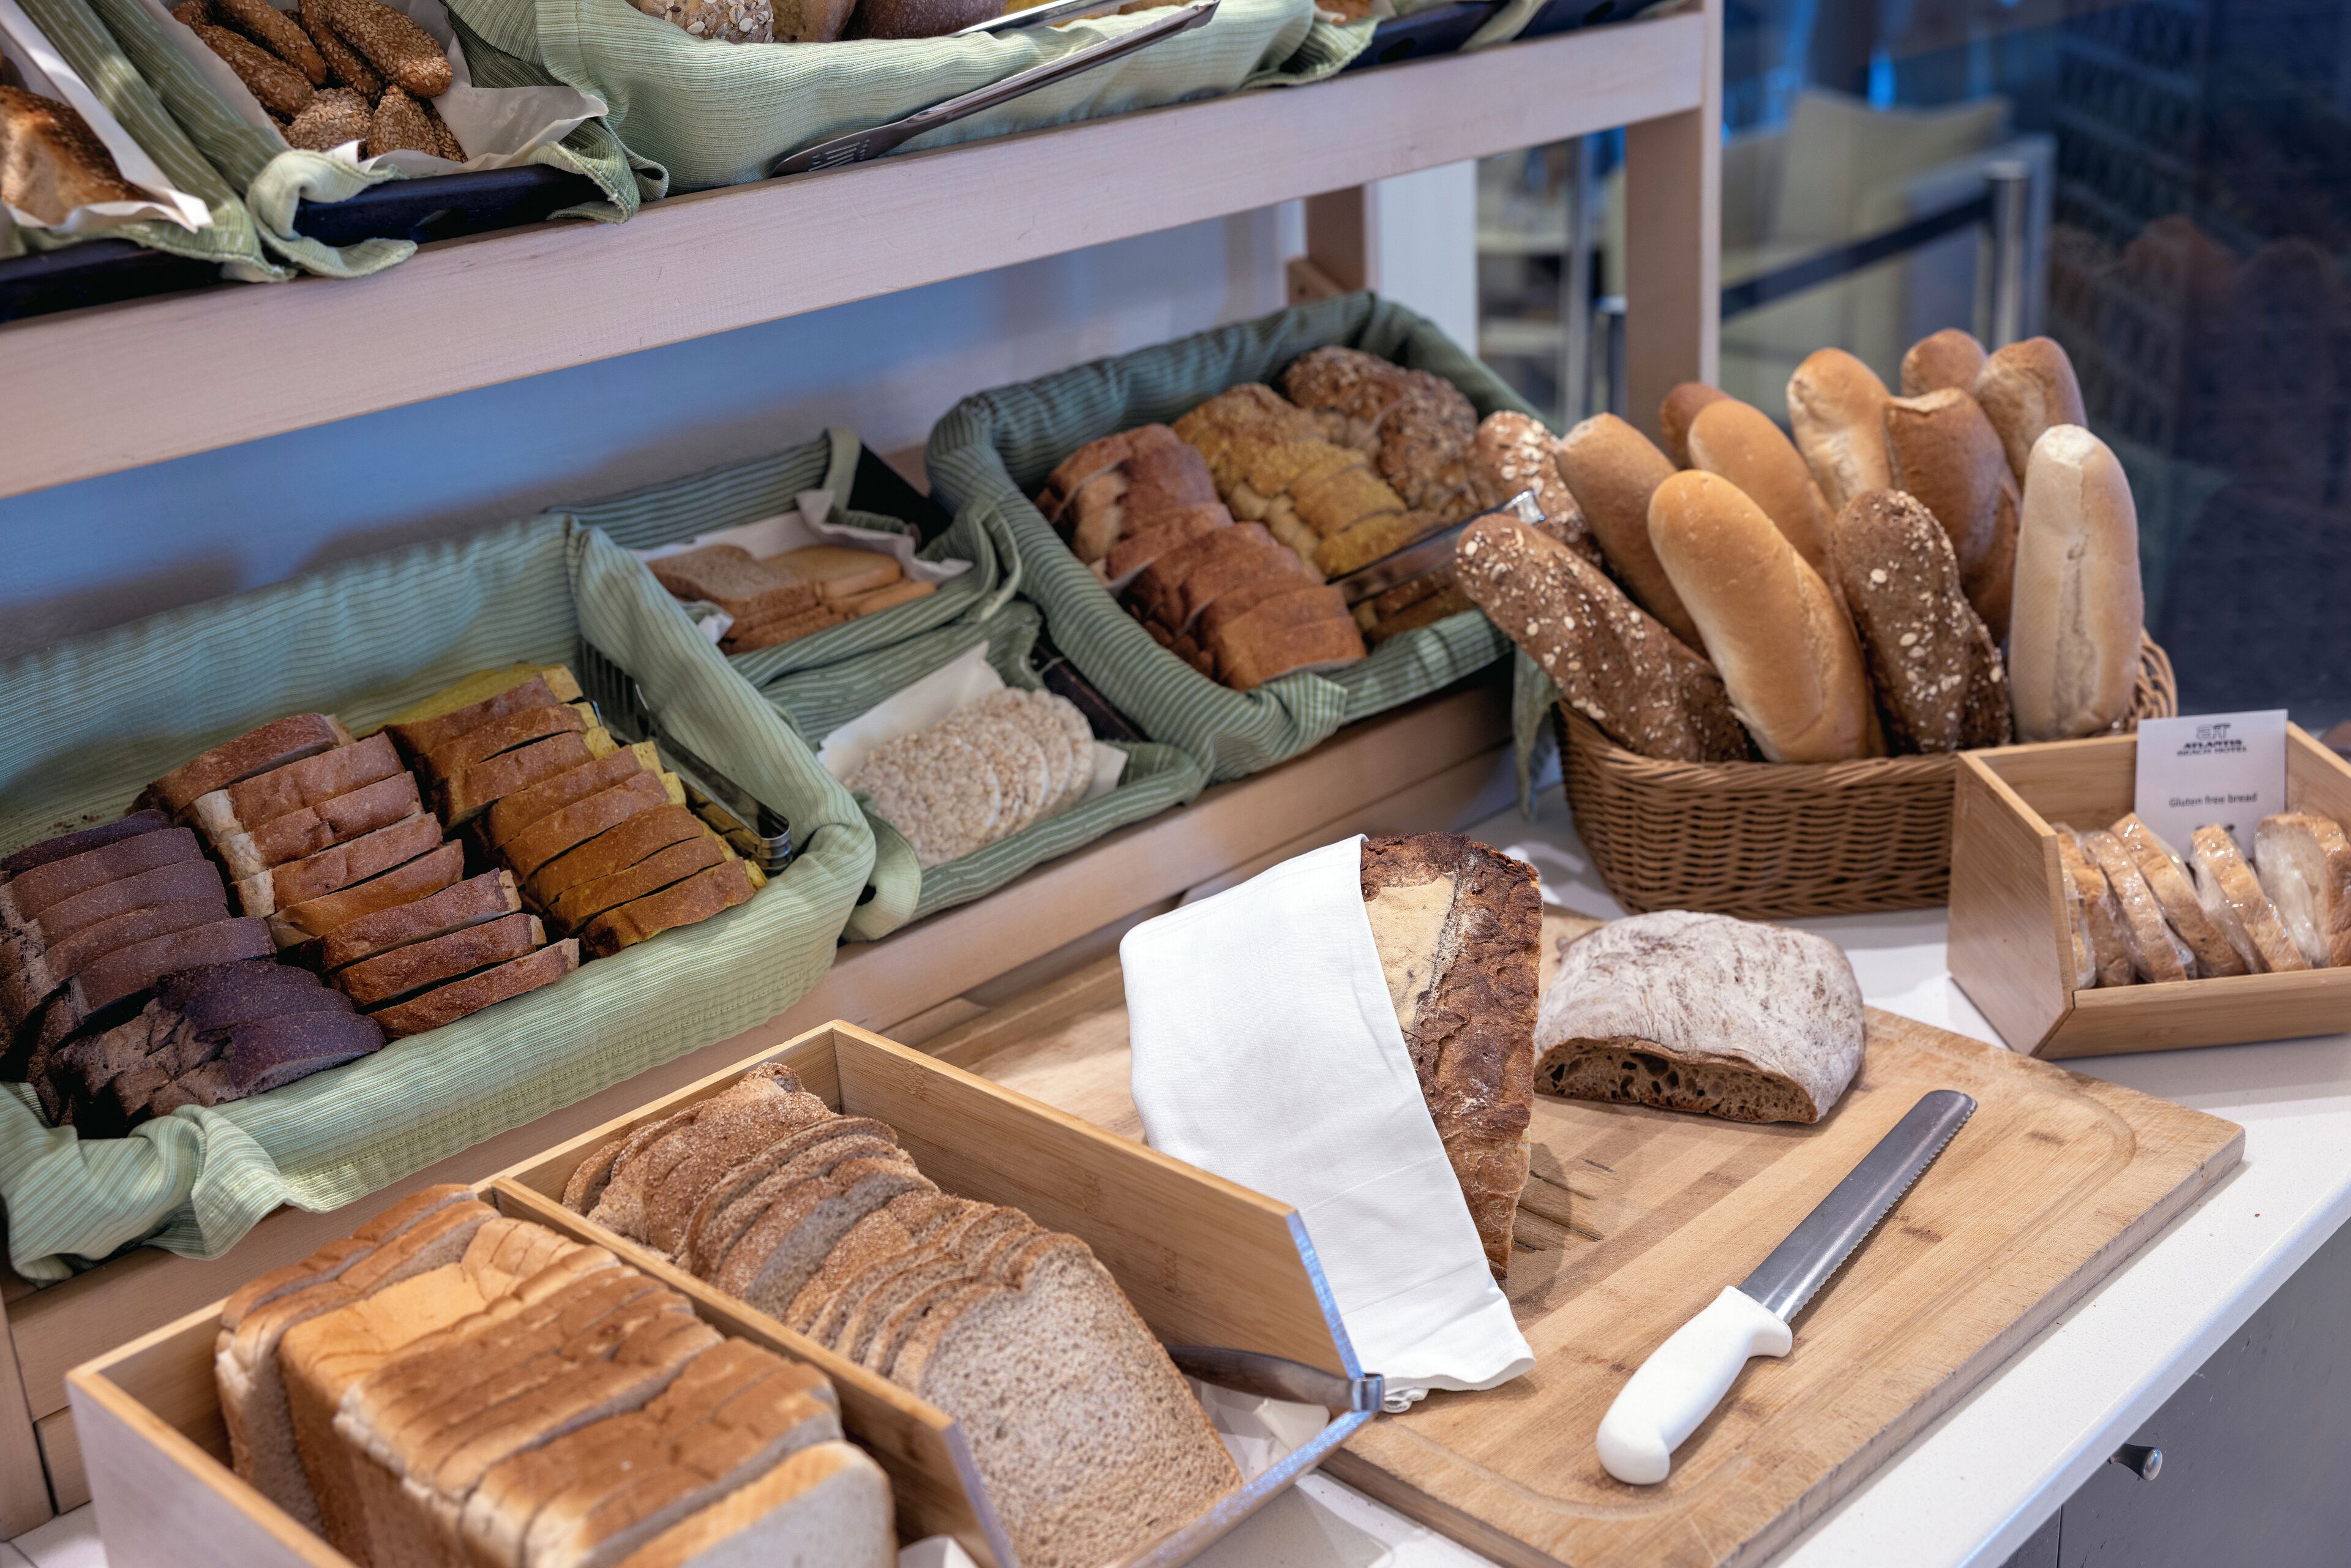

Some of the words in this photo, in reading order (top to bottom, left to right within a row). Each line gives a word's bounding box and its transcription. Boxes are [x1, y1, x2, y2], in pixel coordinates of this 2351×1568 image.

[2183, 739, 2243, 749] ATLANTIS
[2214, 745, 2246, 754] HOTEL
[2169, 797, 2203, 808] Gluten
[2205, 794, 2225, 805] free
[2227, 792, 2257, 803] bread
